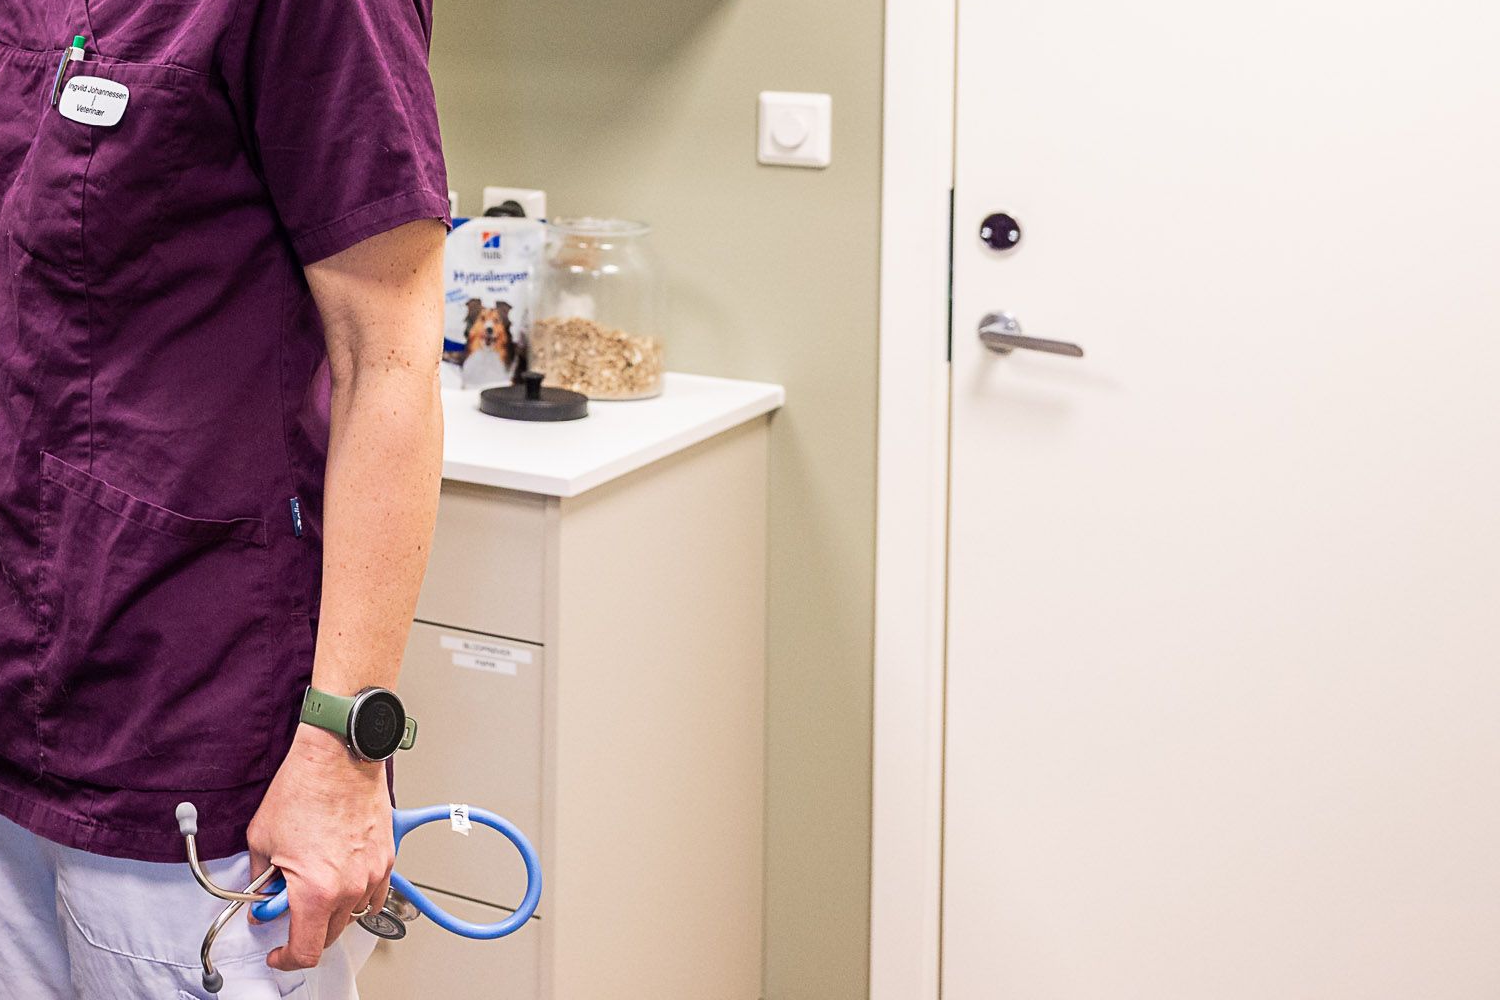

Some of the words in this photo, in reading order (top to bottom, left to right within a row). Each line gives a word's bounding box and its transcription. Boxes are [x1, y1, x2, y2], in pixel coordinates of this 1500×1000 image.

[68, 83, 88, 93] Ingvild
[87, 86, 127, 100] Johannessen
[76, 104, 105, 117] Veterinær
